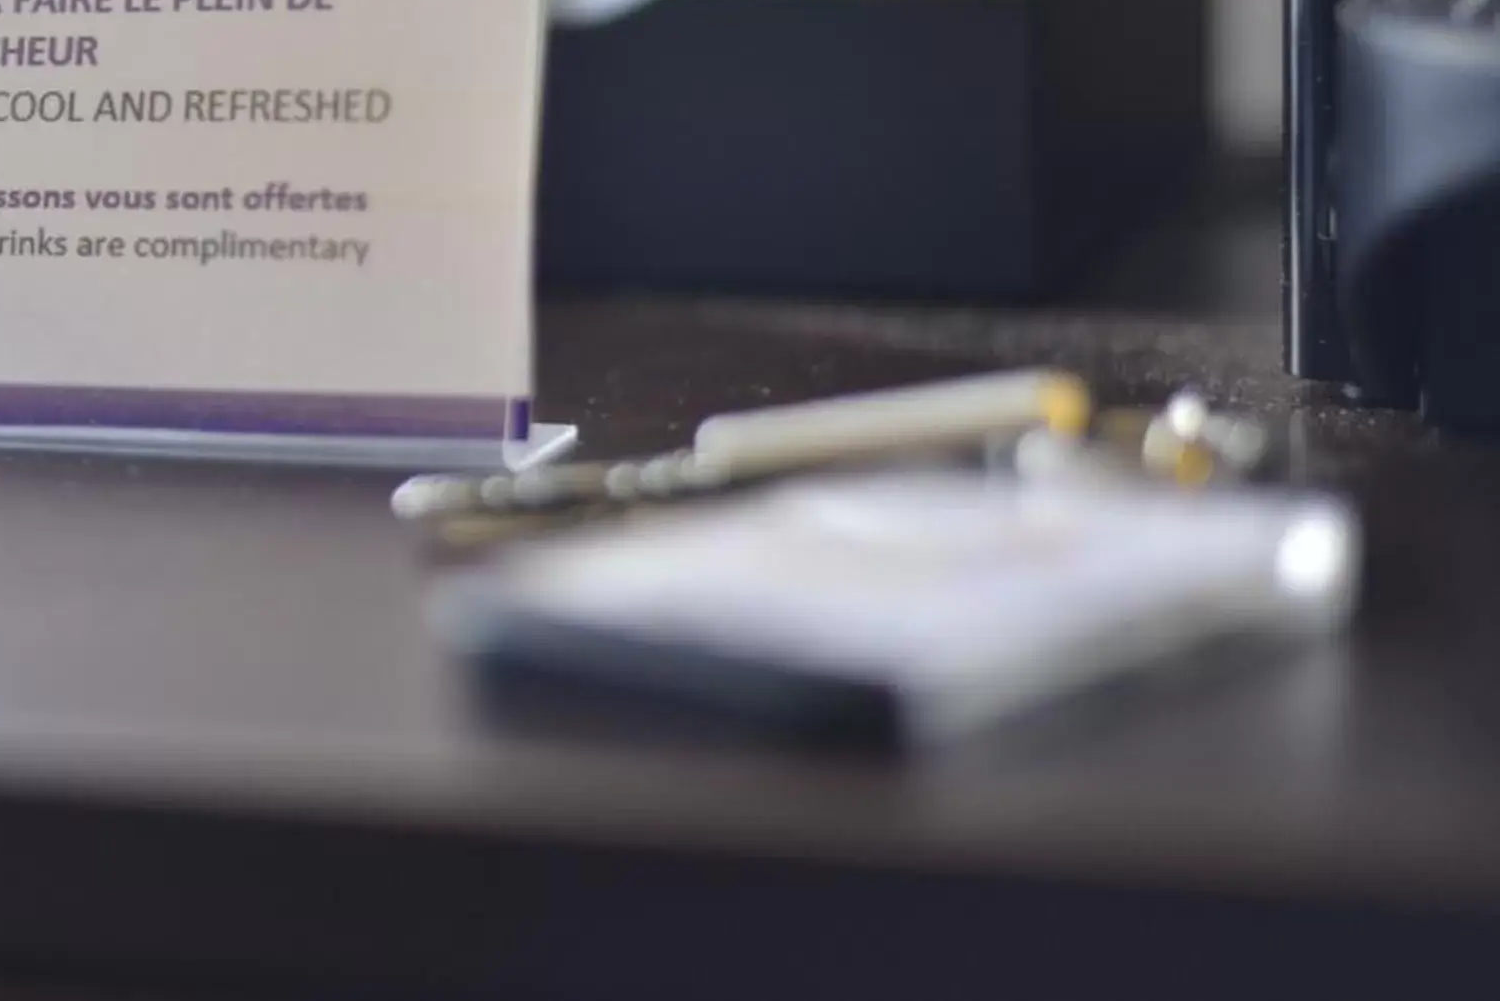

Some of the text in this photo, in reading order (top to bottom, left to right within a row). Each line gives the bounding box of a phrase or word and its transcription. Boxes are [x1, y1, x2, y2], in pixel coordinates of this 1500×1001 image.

[92, 90, 173, 123] AND
[183, 88, 392, 123] REFRESHED
[84, 190, 157, 211] vous
[165, 187, 234, 211] sont
[242, 181, 368, 212] offertes
[76, 236, 126, 258] are
[133, 229, 370, 267] complimentary
